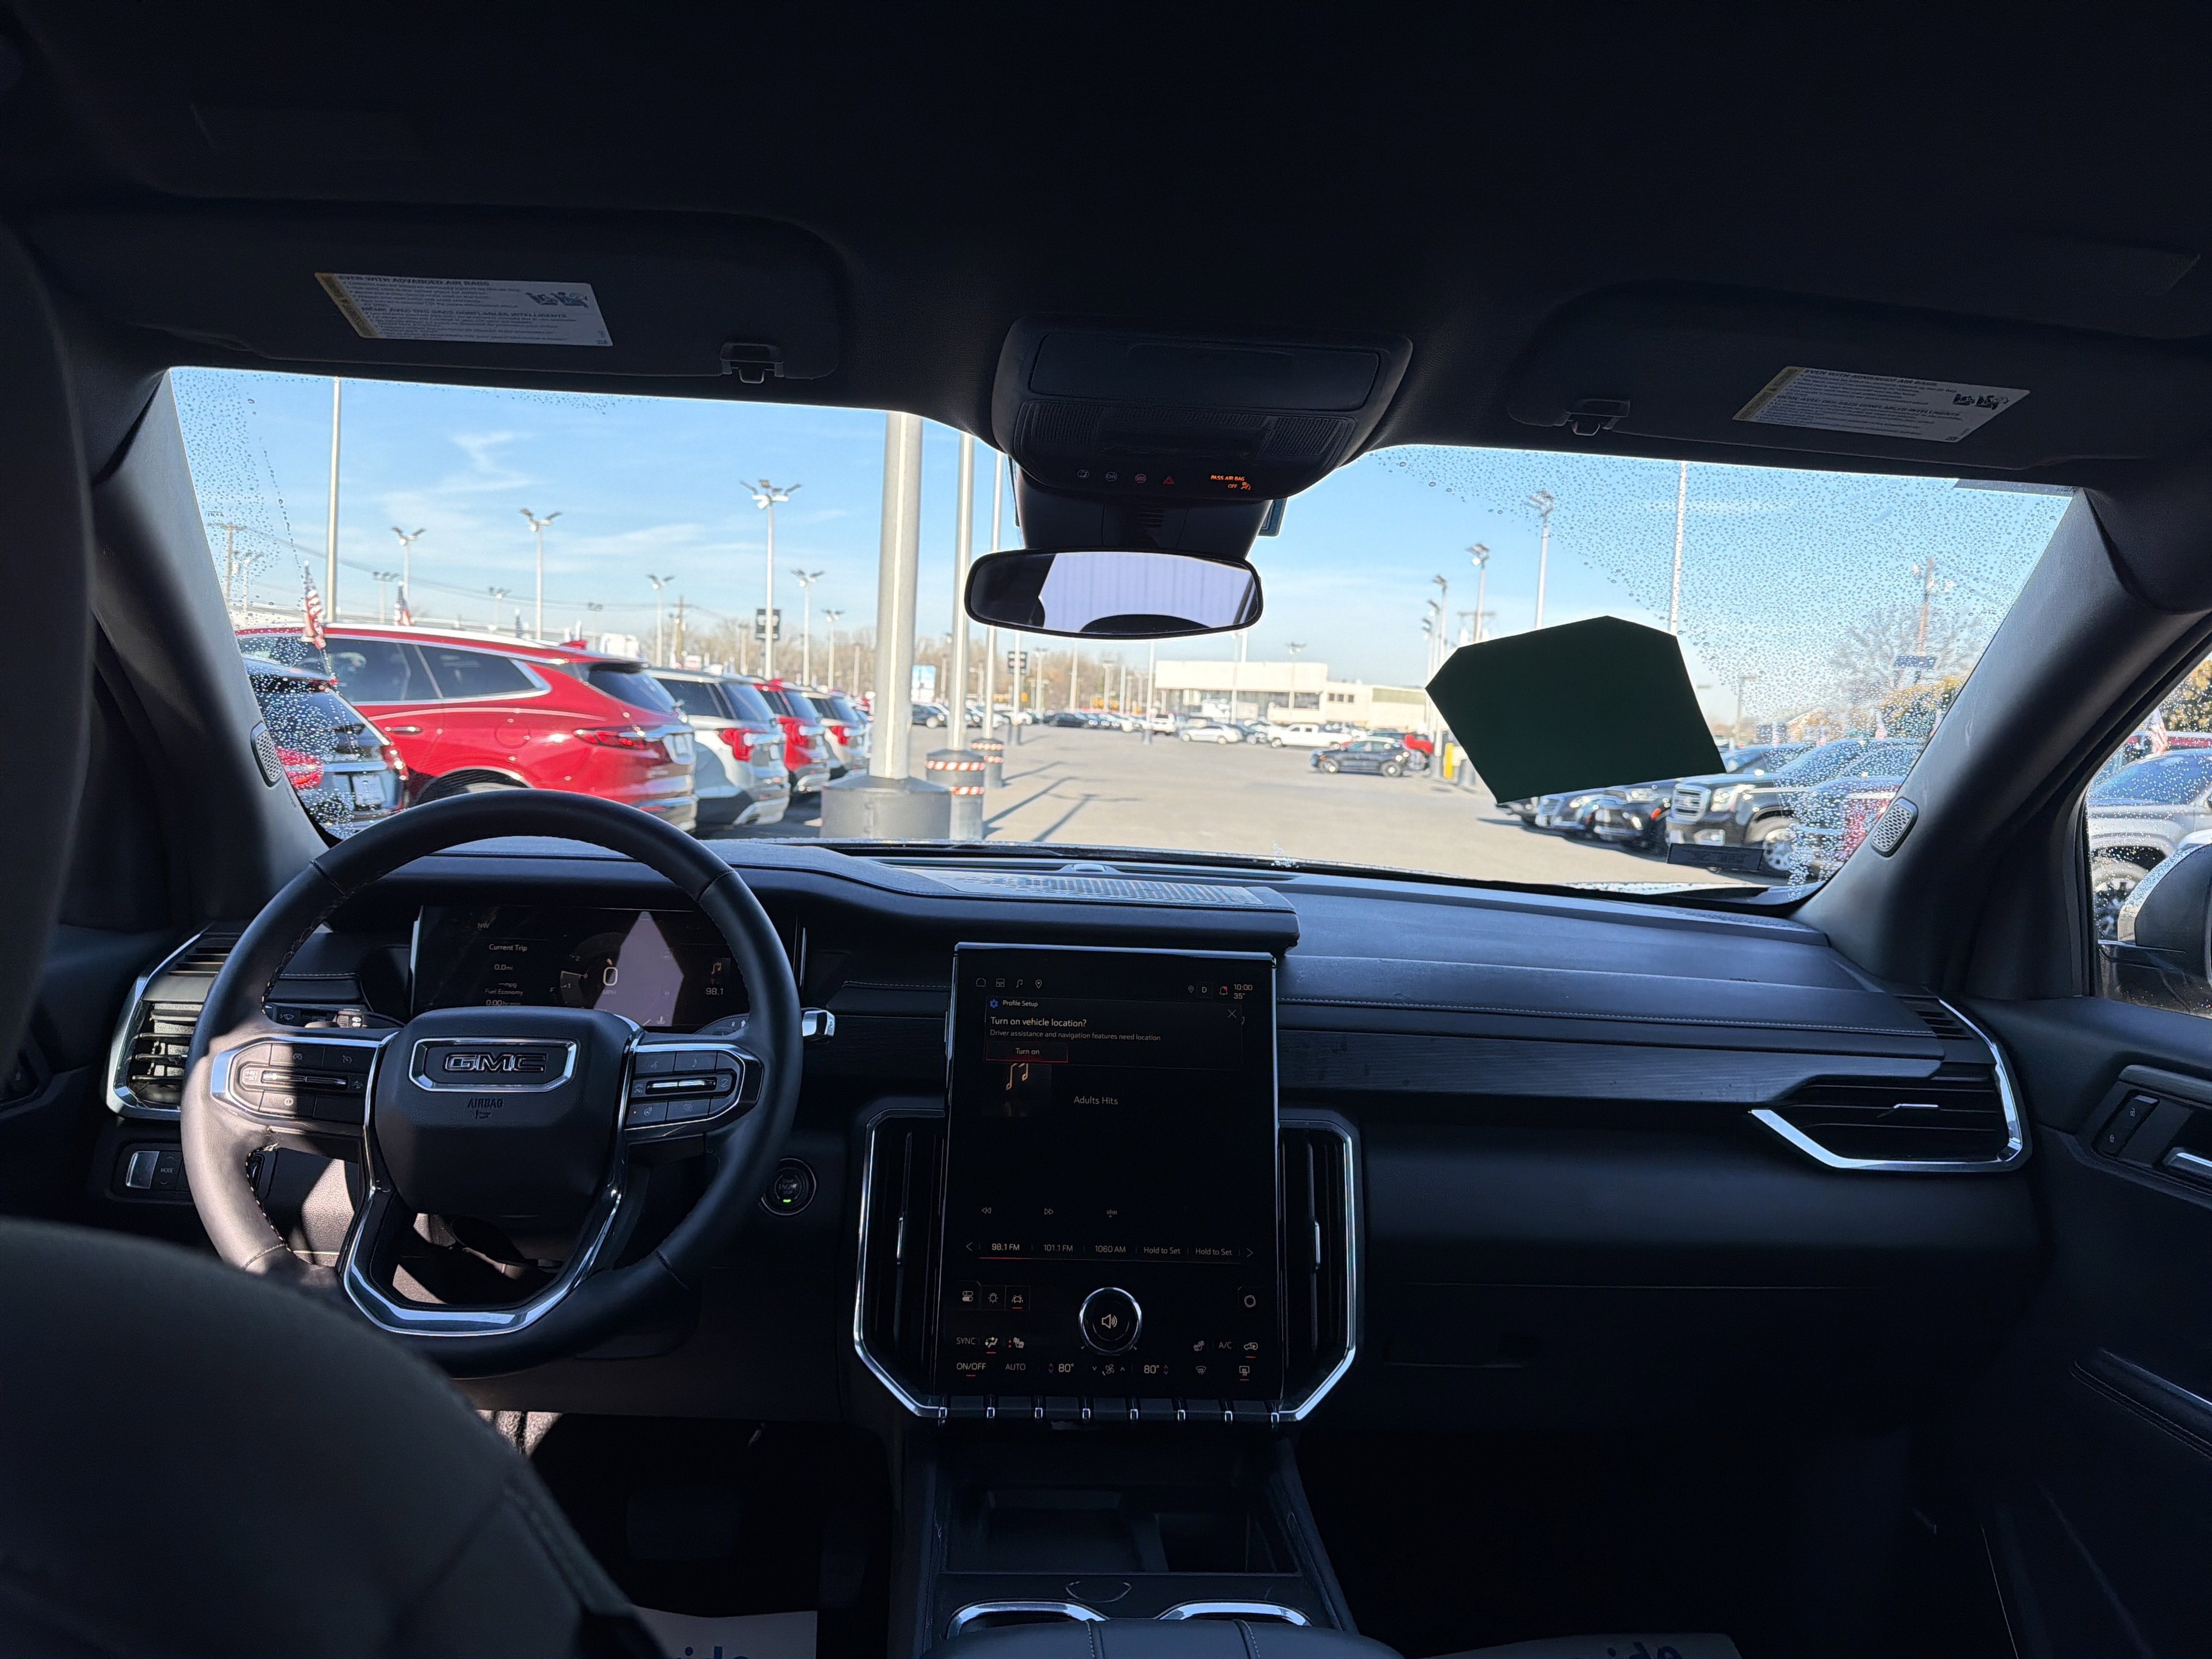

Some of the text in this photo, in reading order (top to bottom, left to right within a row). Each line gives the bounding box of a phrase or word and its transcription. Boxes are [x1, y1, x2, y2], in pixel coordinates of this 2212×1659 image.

[515, 944, 528, 952] Trip
[705, 987, 724, 996] 98.1
[990, 1017, 1008, 1025] Turn
[1022, 1018, 1049, 1026] vehicle
[1051, 1018, 1087, 1028] location?
[1058, 1032, 1091, 1040] navigation
[444, 1052, 548, 1073] GMC
[467, 1098, 504, 1108] AIRBAG
[1074, 1096, 1118, 1105] Adults Hits
[991, 1243, 1020, 1251] 98.1 FM
[1043, 1244, 1061, 1252] 101.1
[1095, 1245, 1113, 1253] 1060
[1169, 1246, 1181, 1255] Set
[956, 1337, 975, 1345] SYNC
[1218, 1341, 1232, 1350] A/C
[956, 1362, 986, 1371] ON/OFF
[1005, 1363, 1026, 1371] AUTO
